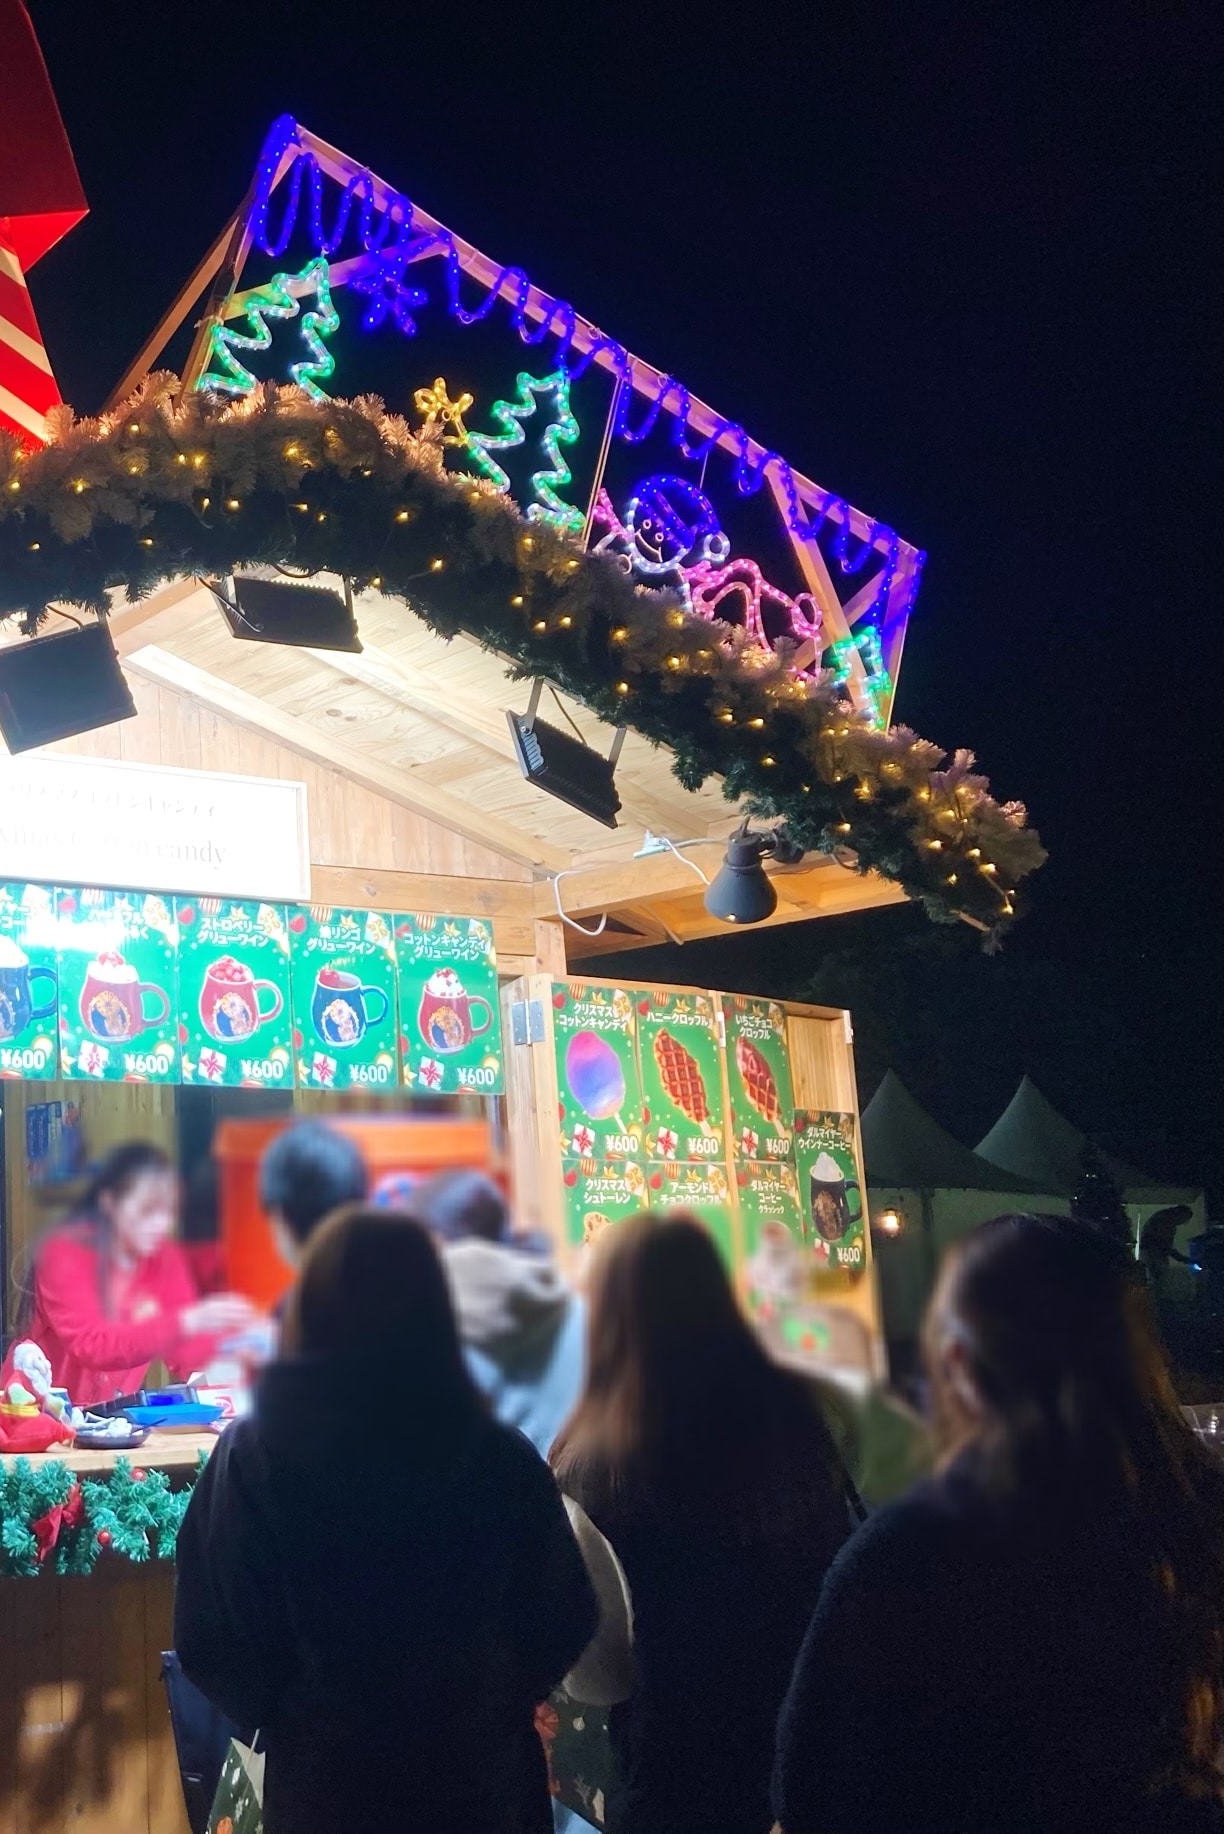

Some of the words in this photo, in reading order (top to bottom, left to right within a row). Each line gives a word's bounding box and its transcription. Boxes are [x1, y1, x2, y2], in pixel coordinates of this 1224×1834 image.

[201, 917, 265, 933] ストロベリー
[197, 930, 269, 947] グリューワイン
[306, 937, 376, 955] グリューワイン
[404, 932, 487, 949] コットンキャンディ
[414, 945, 480, 960] グリューワイン
[573, 1003, 615, 1018] クリスマス
[646, 1011, 711, 1027] ハニークロッフル
[559, 1014, 628, 1032] コットンキャンディ
[735, 1014, 774, 1029] いちごチョコ
[740, 1026, 771, 1041] クロッフル
[0, 1047, 46, 1068] ¥600
[125, 1053, 168, 1073] ¥600
[241, 1059, 284, 1079] ¥600
[349, 1063, 388, 1082] ¥600
[457, 1066, 495, 1085] ¥600
[605, 1134, 638, 1152] ¥600
[688, 1137, 719, 1154] ¥600
[766, 1138, 790, 1155] ¥600
[585, 1178, 626, 1193] クリスマス
[670, 1181, 710, 1194] アーモンド
[583, 1190, 631, 1204] シュトーレン
[758, 1193, 782, 1204] コーヒー
[837, 1247, 860, 1263] ¥600
